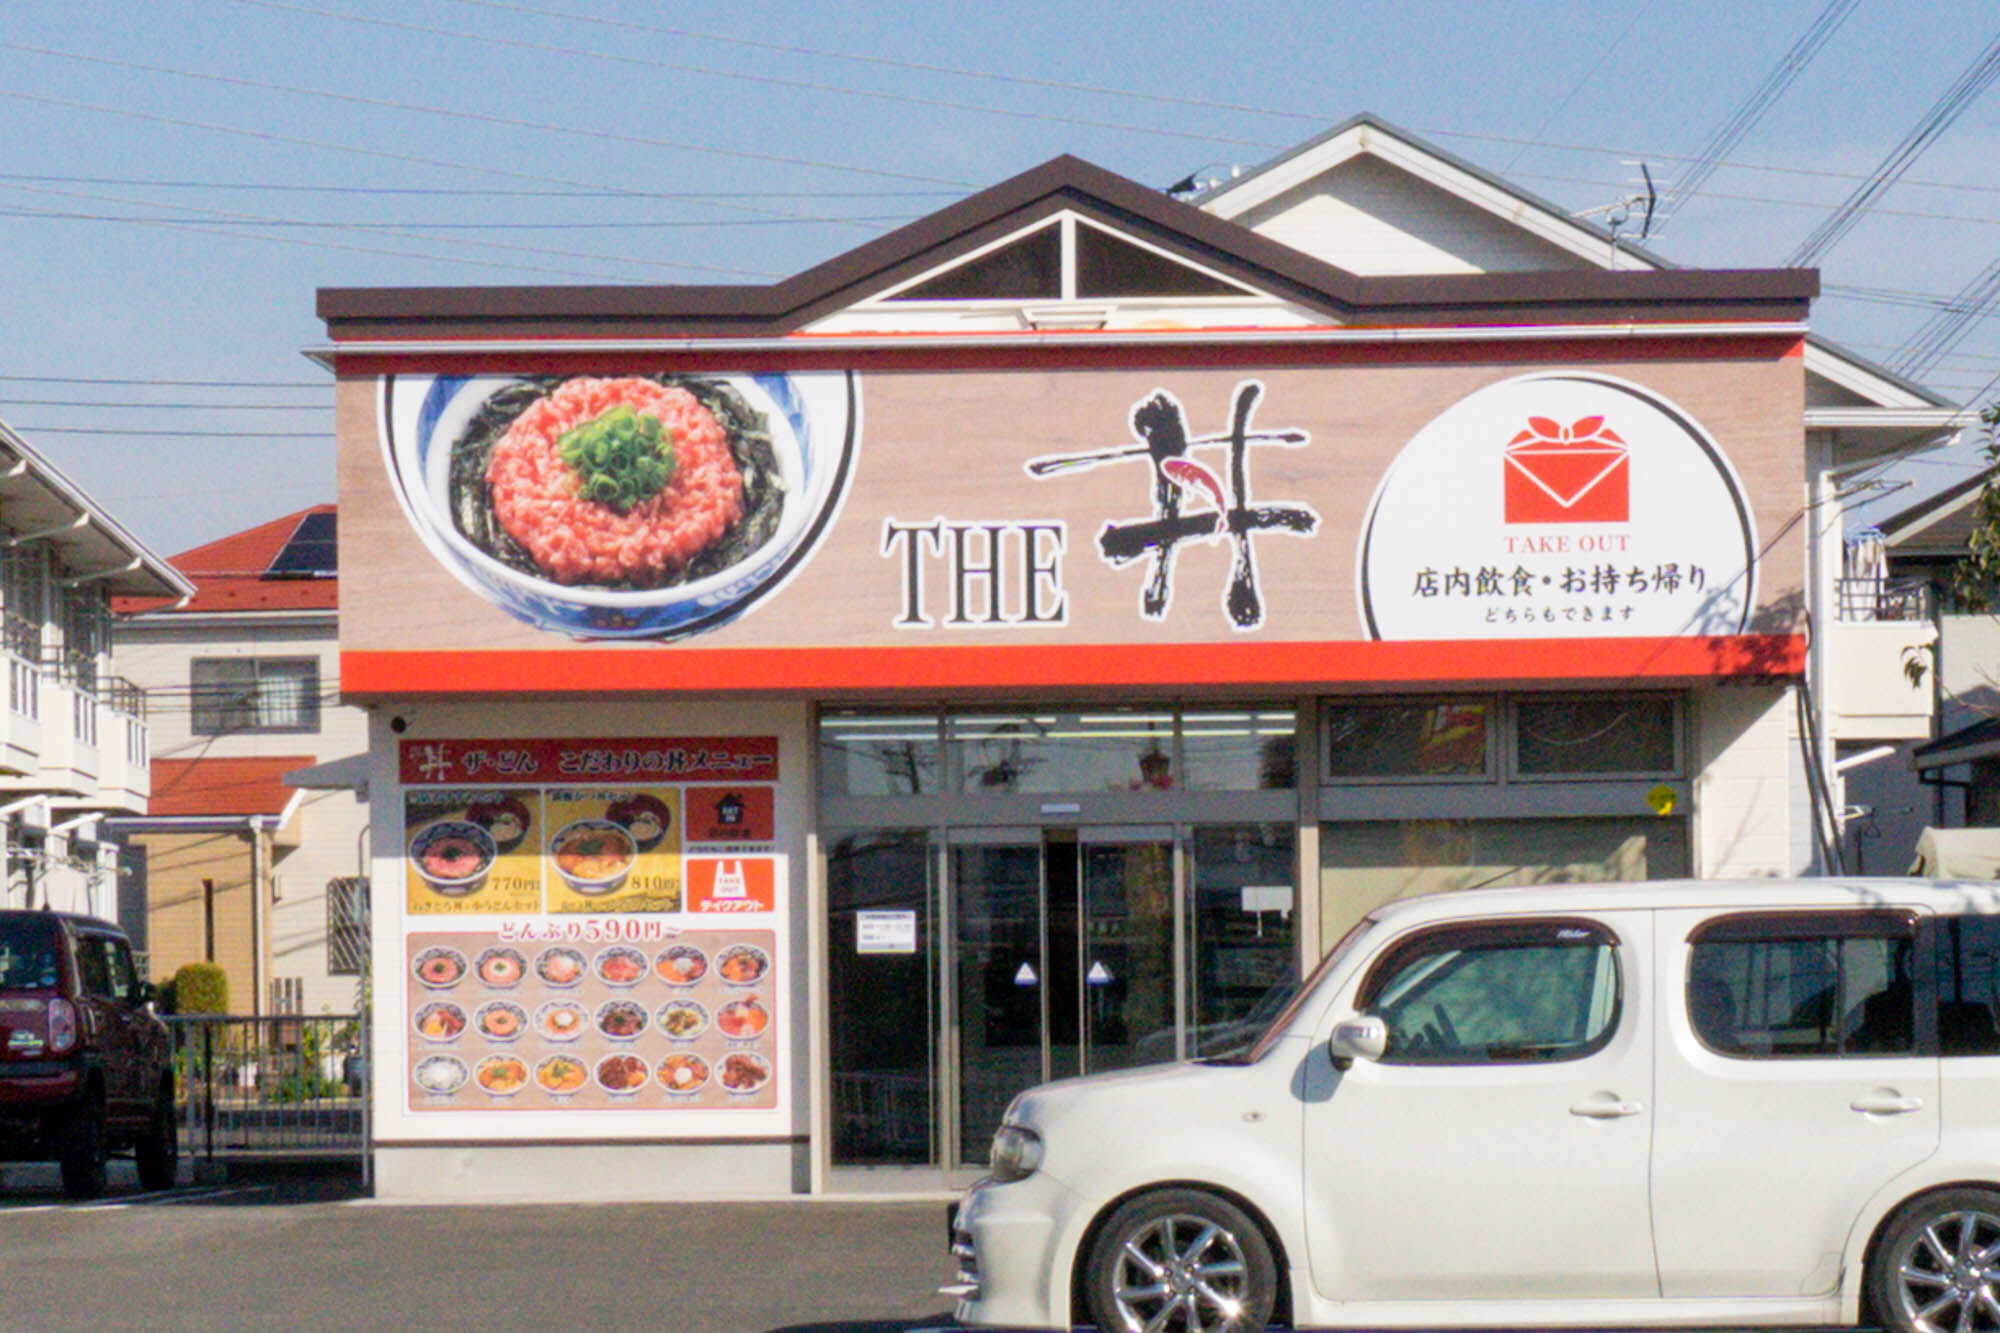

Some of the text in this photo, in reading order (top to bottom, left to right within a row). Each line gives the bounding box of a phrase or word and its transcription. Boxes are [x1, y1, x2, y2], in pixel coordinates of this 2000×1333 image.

[1504, 534, 1631, 553] TAKE OUT
[885, 522, 1065, 624] THE
[1412, 563, 1706, 598] 店内飲食・お持ち帰り
[1485, 605, 1635, 623] どちらもできます
